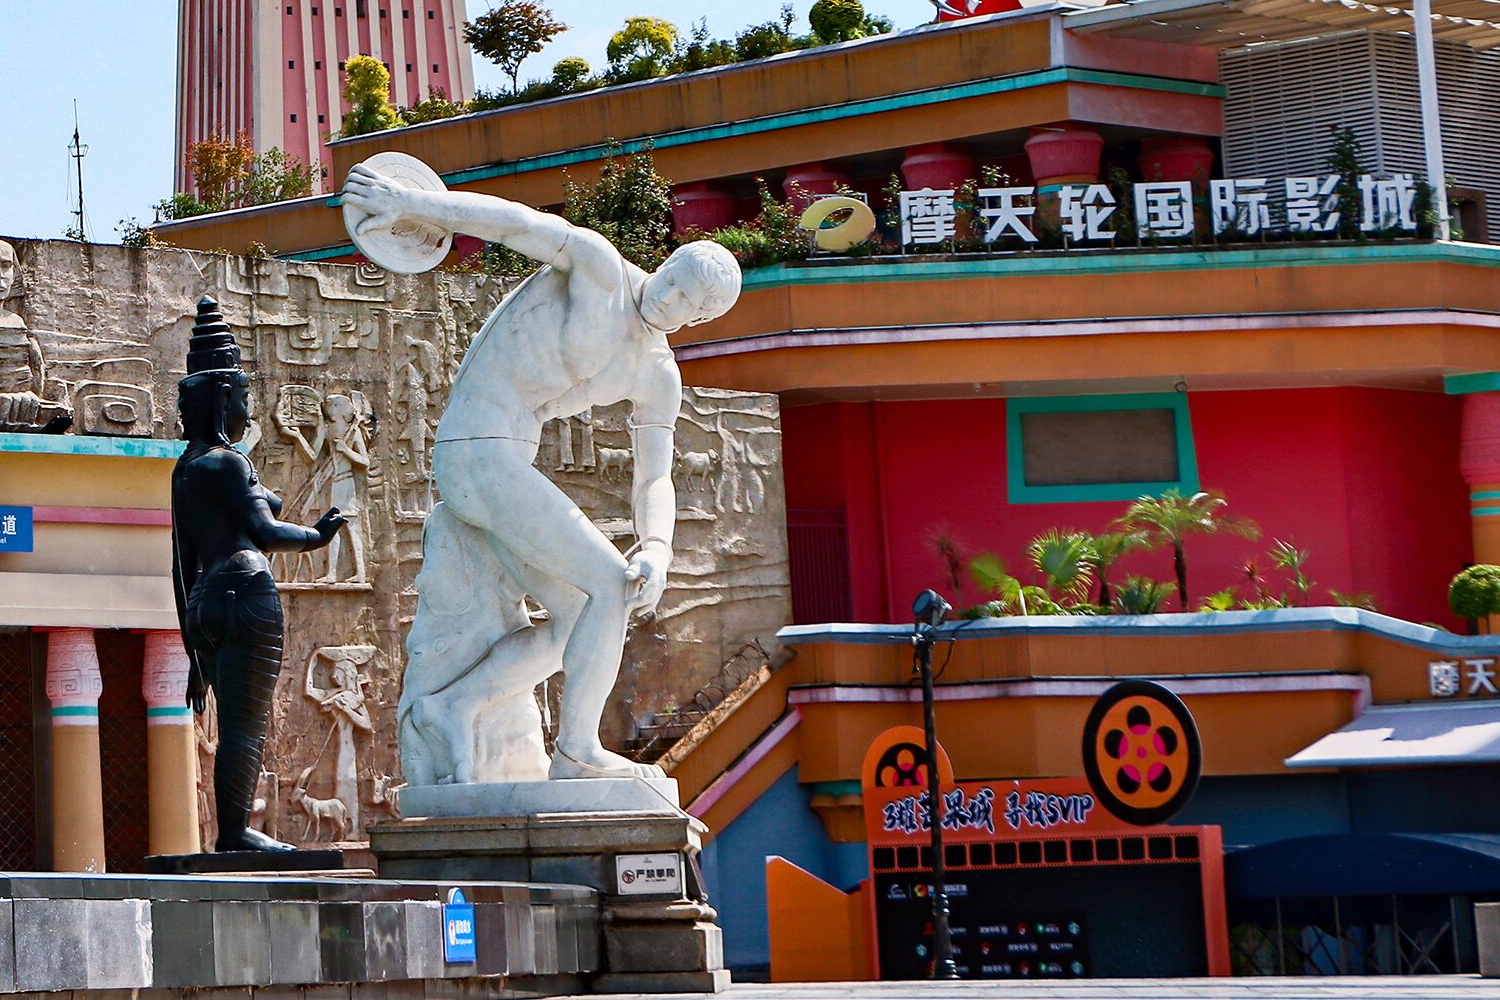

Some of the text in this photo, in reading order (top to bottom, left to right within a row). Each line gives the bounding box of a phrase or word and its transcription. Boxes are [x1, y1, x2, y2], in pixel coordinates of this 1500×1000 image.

[899, 174, 1418, 244] 摩天轮国际影城
